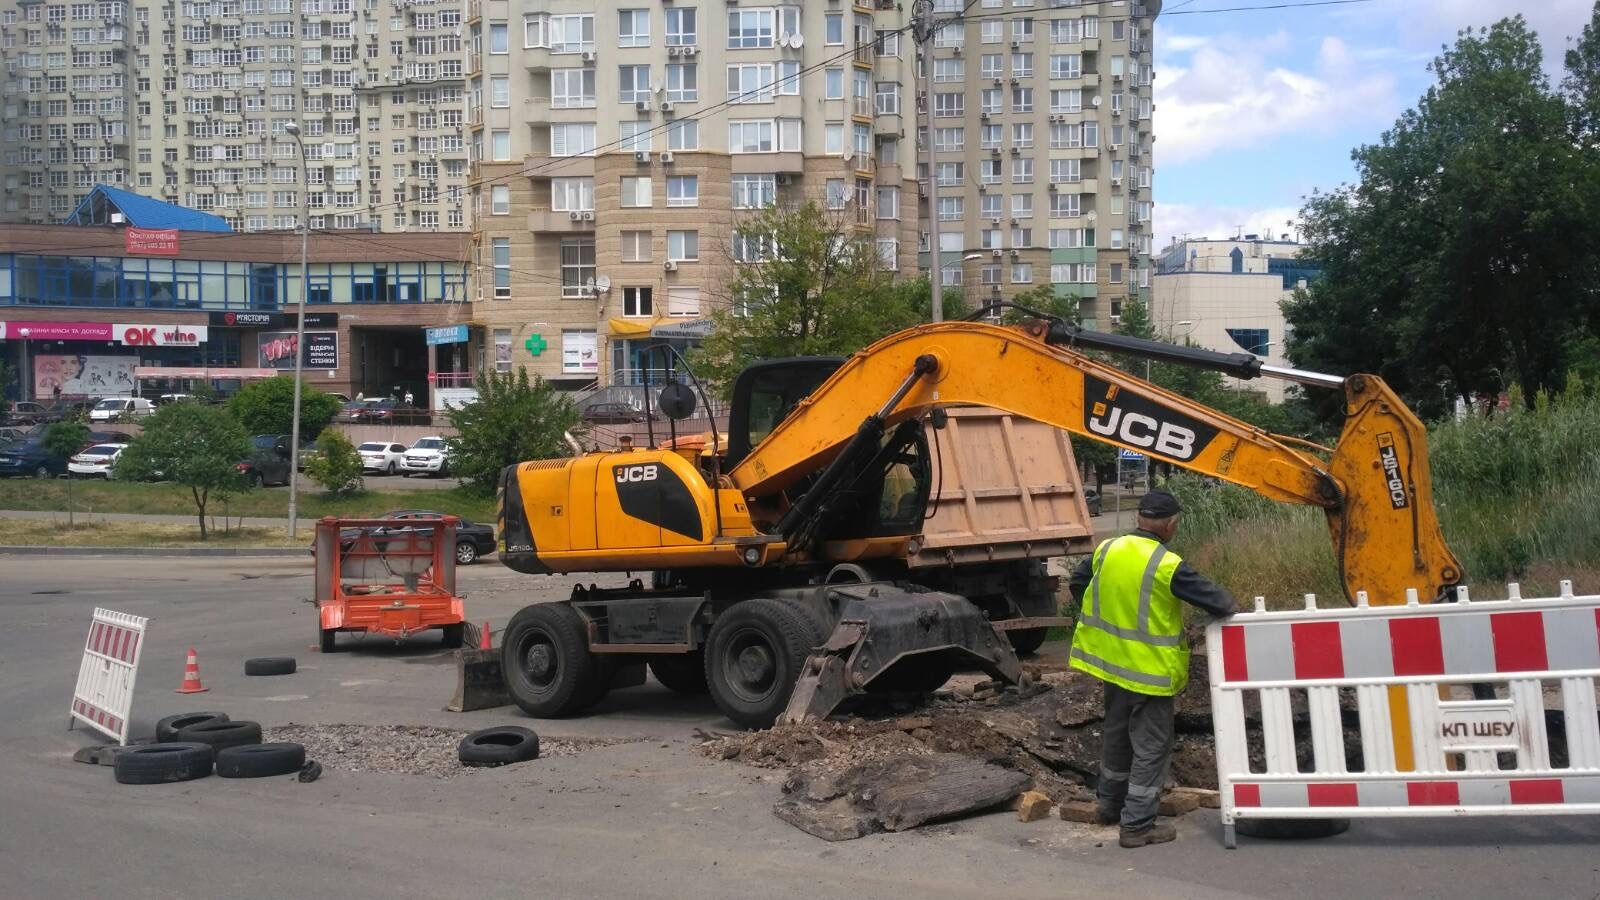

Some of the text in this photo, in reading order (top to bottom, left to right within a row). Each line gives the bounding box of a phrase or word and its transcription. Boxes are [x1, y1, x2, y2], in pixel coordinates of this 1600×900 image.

[163, 325, 196, 342] wine
[1089, 406, 1196, 460] JCB
[616, 465, 658, 483] JCB
[1442, 722, 1514, 737] КП ШЕУ
